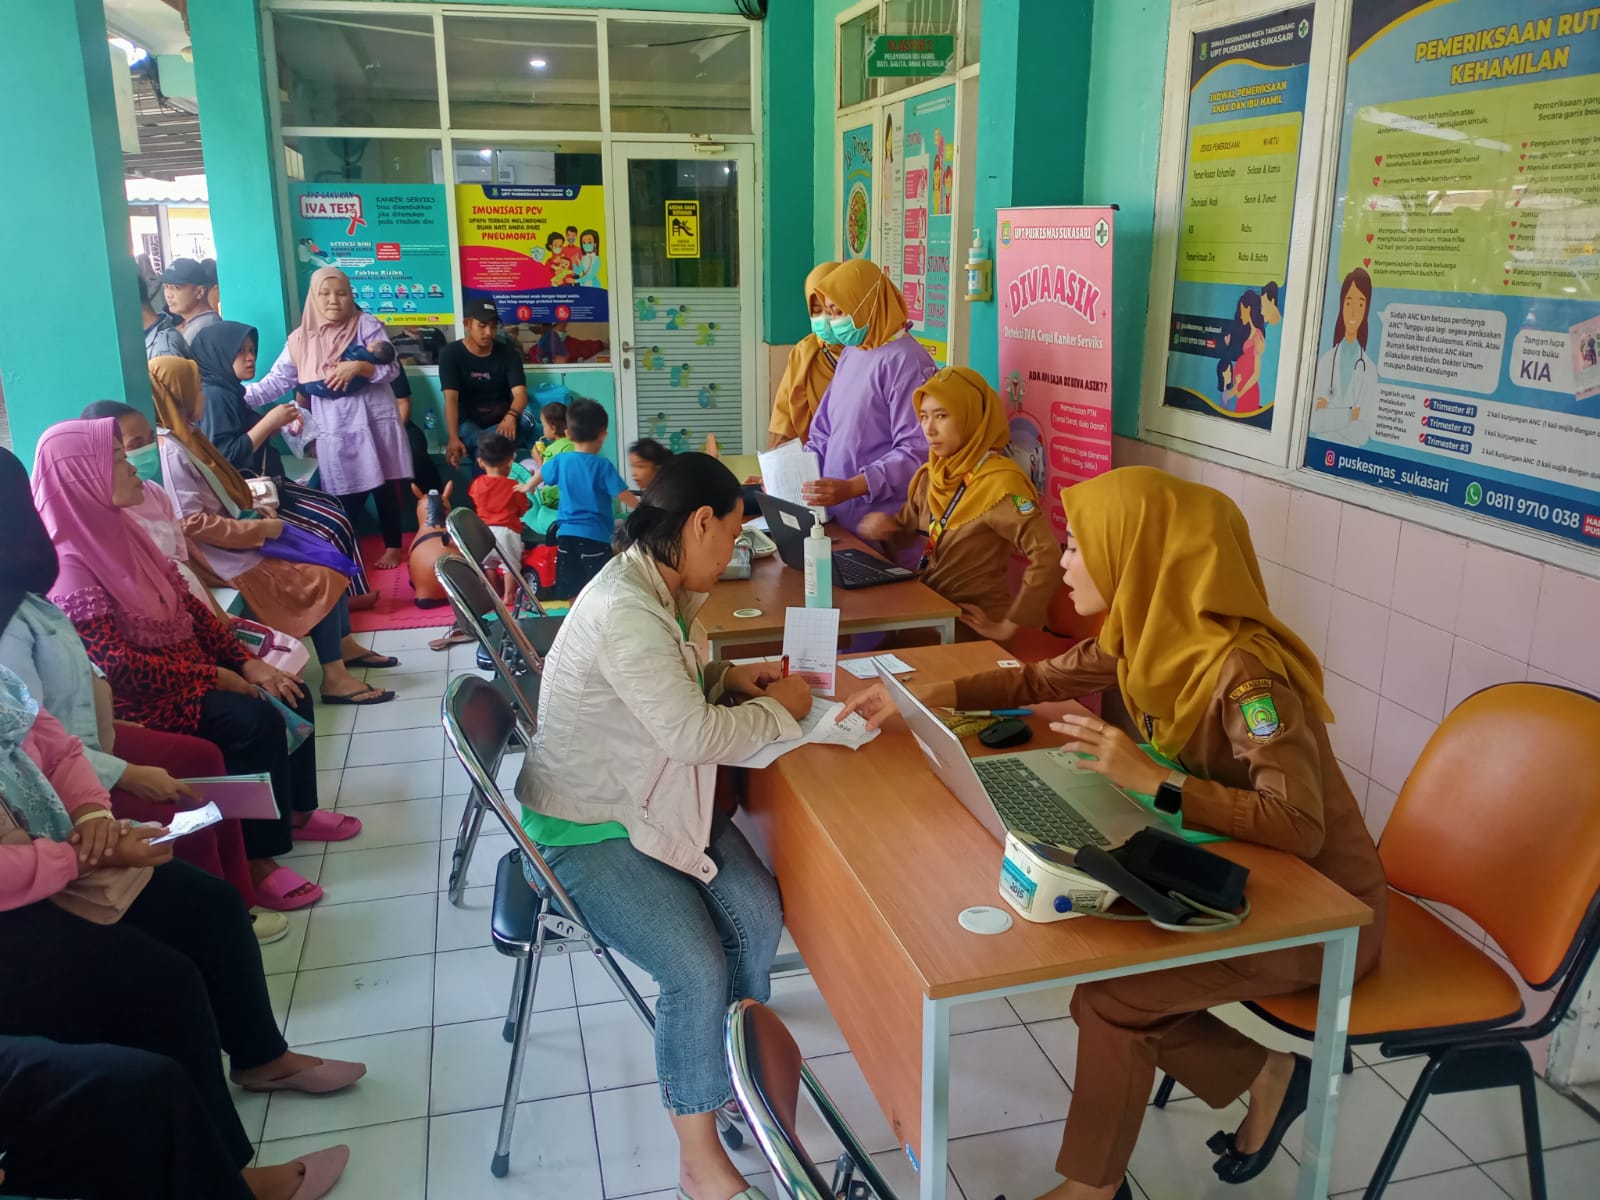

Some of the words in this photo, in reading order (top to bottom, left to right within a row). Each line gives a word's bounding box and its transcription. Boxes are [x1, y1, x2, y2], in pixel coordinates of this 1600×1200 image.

[1210, 49, 1222, 58] UPT
[1222, 41, 1259, 55] PUSKESMAS
[1260, 32, 1294, 48] SUKASARI
[1415, 17, 1553, 63] PEMERIKSAAN
[1450, 45, 1571, 85] KEHAMILAN
[1208, 90, 1237, 102] JADWAL
[1237, 81, 1287, 98] PEMERIKSAAN
[1211, 103, 1230, 113] ANAK
[1231, 101, 1246, 110] DAN
[1247, 98, 1258, 109] IBU
[1259, 94, 1284, 107] HAMIL
[305, 203, 328, 214] IVA
[329, 203, 357, 214] TEST
[472, 206, 523, 215] IMUNISASI
[525, 206, 543, 215] PCV
[482, 232, 537, 241] PNEUMONIA
[1025, 226, 1059, 240] PUSKESMAS
[1059, 226, 1091, 240] SUKASARI
[1407, 313, 1419, 321] ANC
[1076, 334, 1103, 350] Serviks
[1523, 335, 1549, 347] Jangan
[1549, 339, 1565, 349] lupa
[1541, 349, 1560, 359] buku
[1520, 359, 1552, 383] KIA
[1433, 401, 1465, 414] Trimester
[1465, 405, 1475, 416] #1
[1429, 418, 1462, 431] Trimester
[1462, 424, 1472, 434] #2
[1528, 418, 1541, 426] ANC
[1426, 436, 1459, 449] Trimester
[1459, 442, 1469, 453] #3
[1337, 455, 1449, 494] puskesmas_sukasari
[1486, 491, 1514, 511] 0811
[1516, 498, 1549, 521] 9710
[1552, 508, 1580, 529] 038
